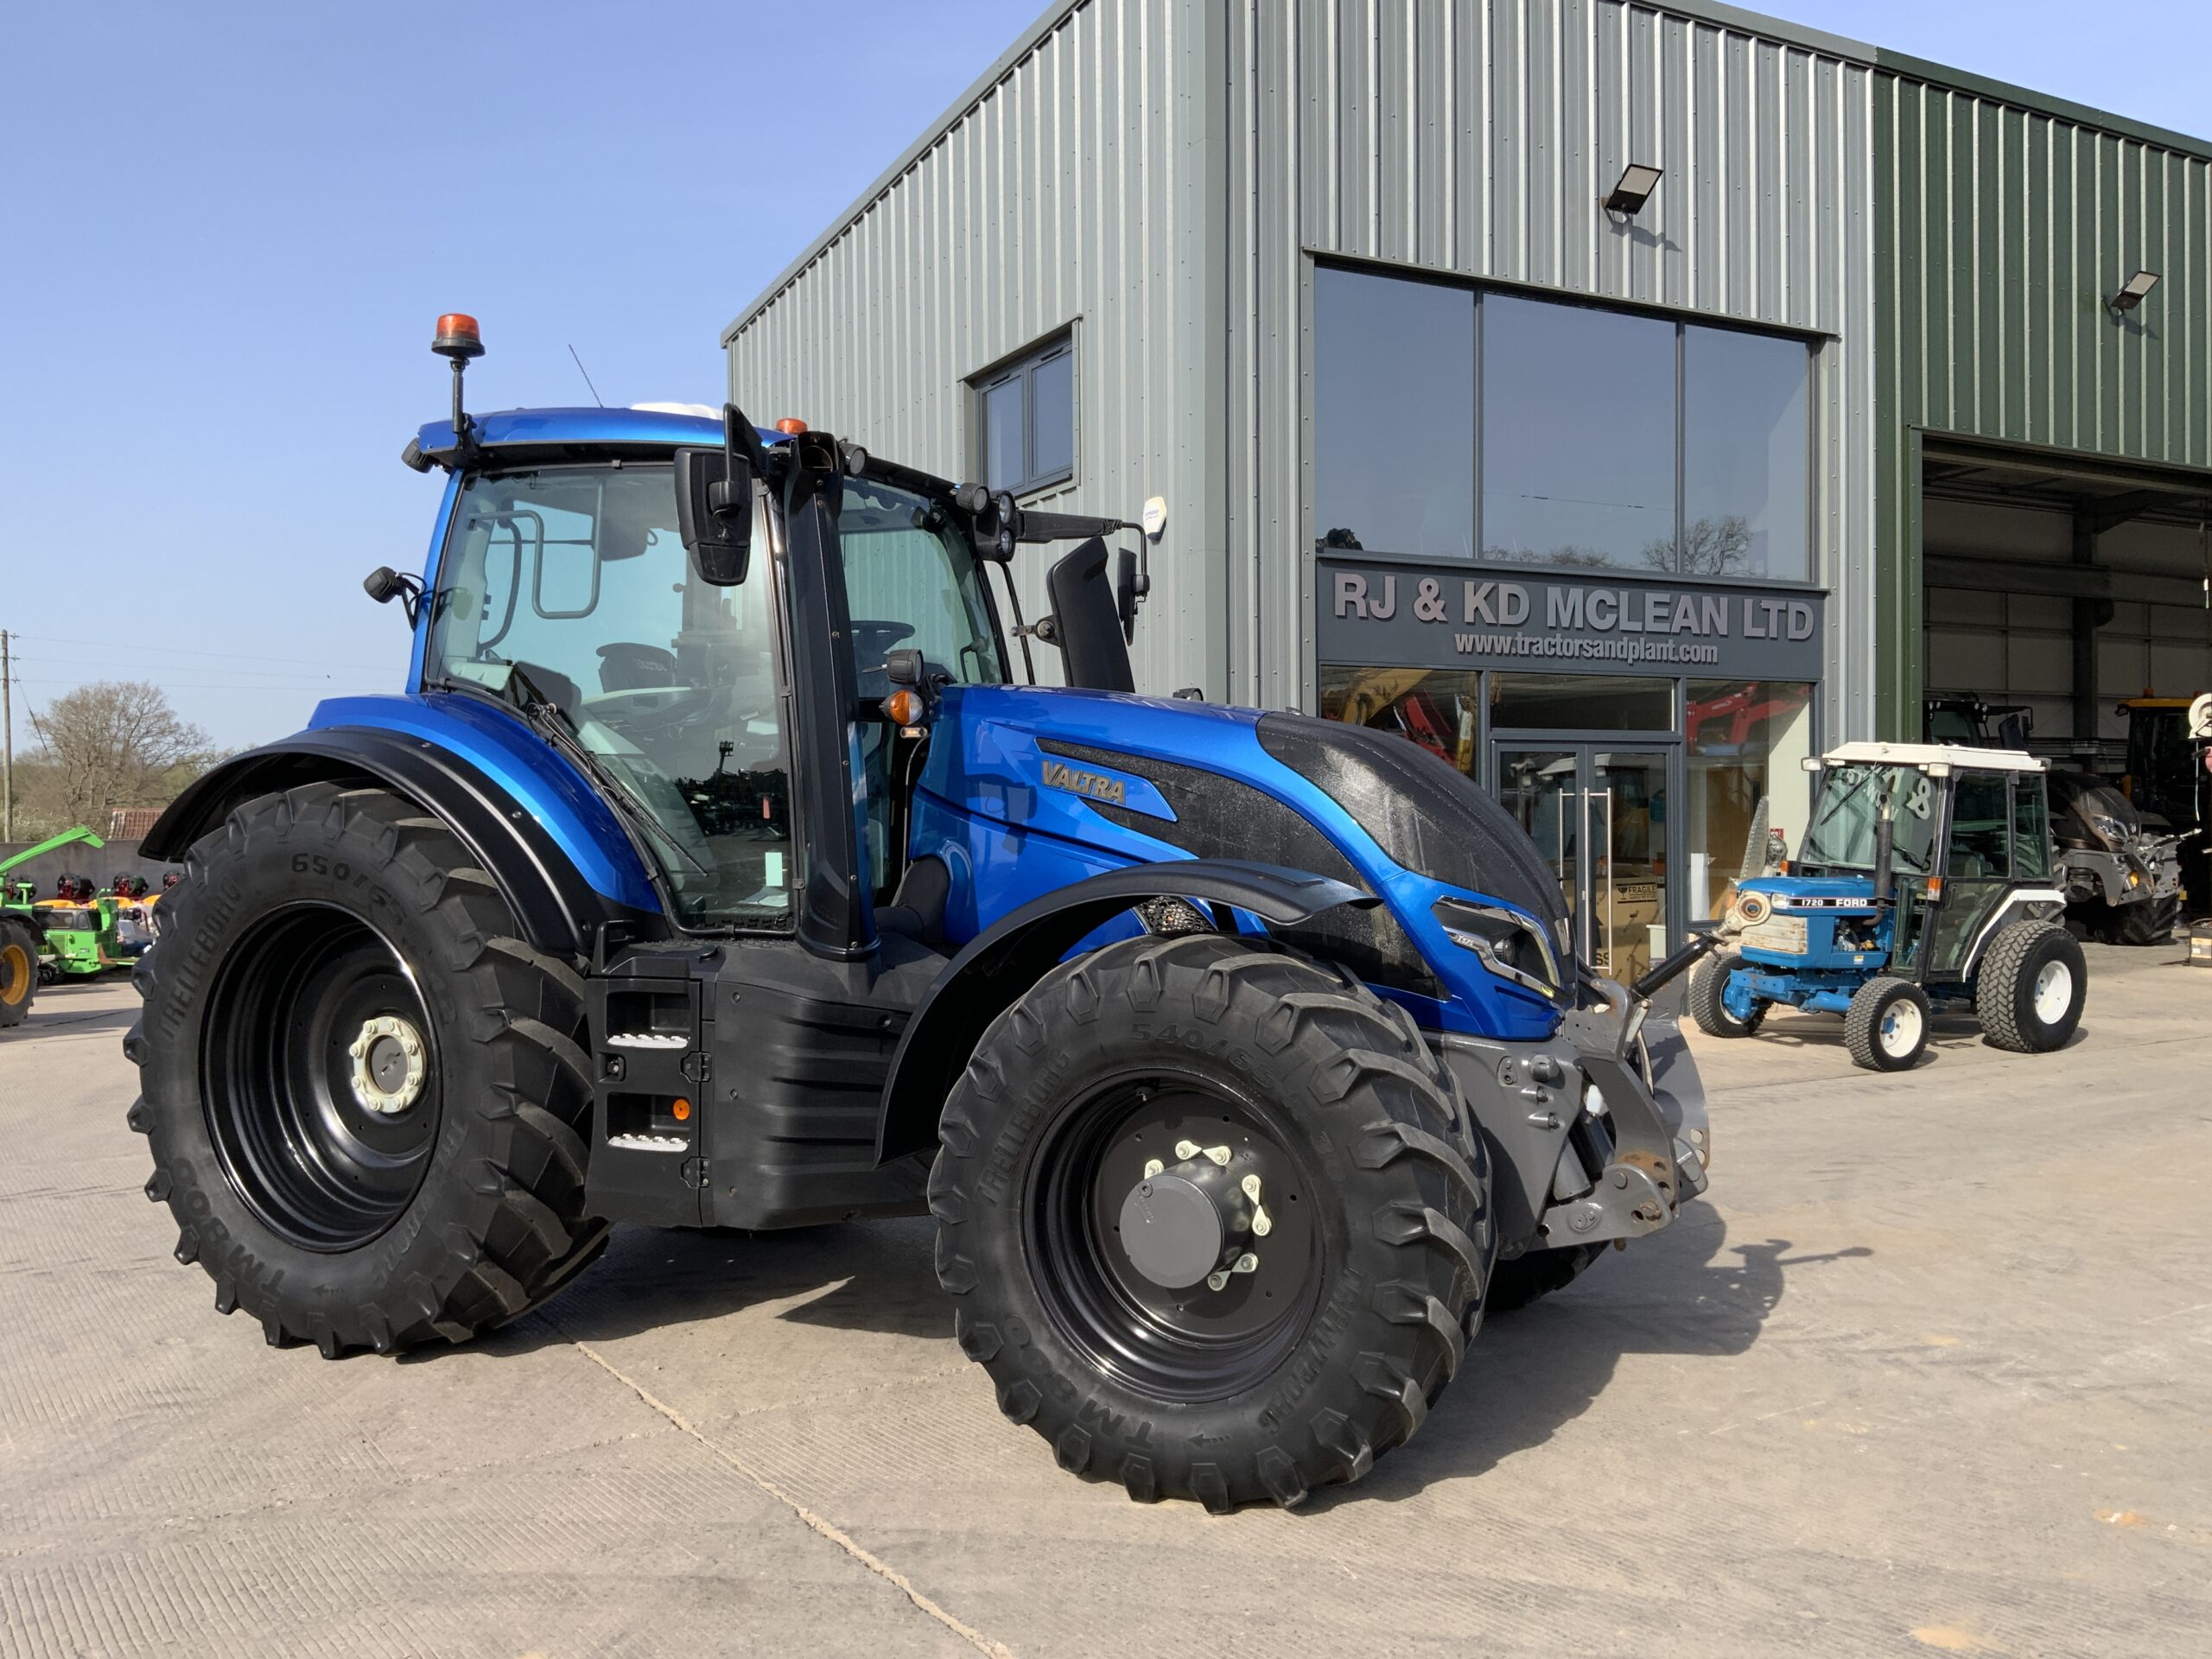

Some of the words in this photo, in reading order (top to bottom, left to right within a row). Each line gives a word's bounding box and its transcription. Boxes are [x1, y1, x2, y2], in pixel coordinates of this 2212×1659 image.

[1334, 573, 1395, 619] RJ
[1414, 578, 1448, 621] &
[1465, 581, 1529, 625] KD
[1547, 586, 1728, 636] MCLEAN
[1744, 599, 1815, 640] LTD
[1454, 631, 1719, 664] www.tractorsandplant.com
[1042, 760, 1126, 804] VALTRA
[1629, 885, 1656, 894] FRAGILE
[1801, 898, 1824, 907] 1720
[1835, 898, 1868, 907] FORD
[158, 875, 242, 1039] TRELLEBORG
[974, 1047, 1071, 1209] TRELLEBORG
